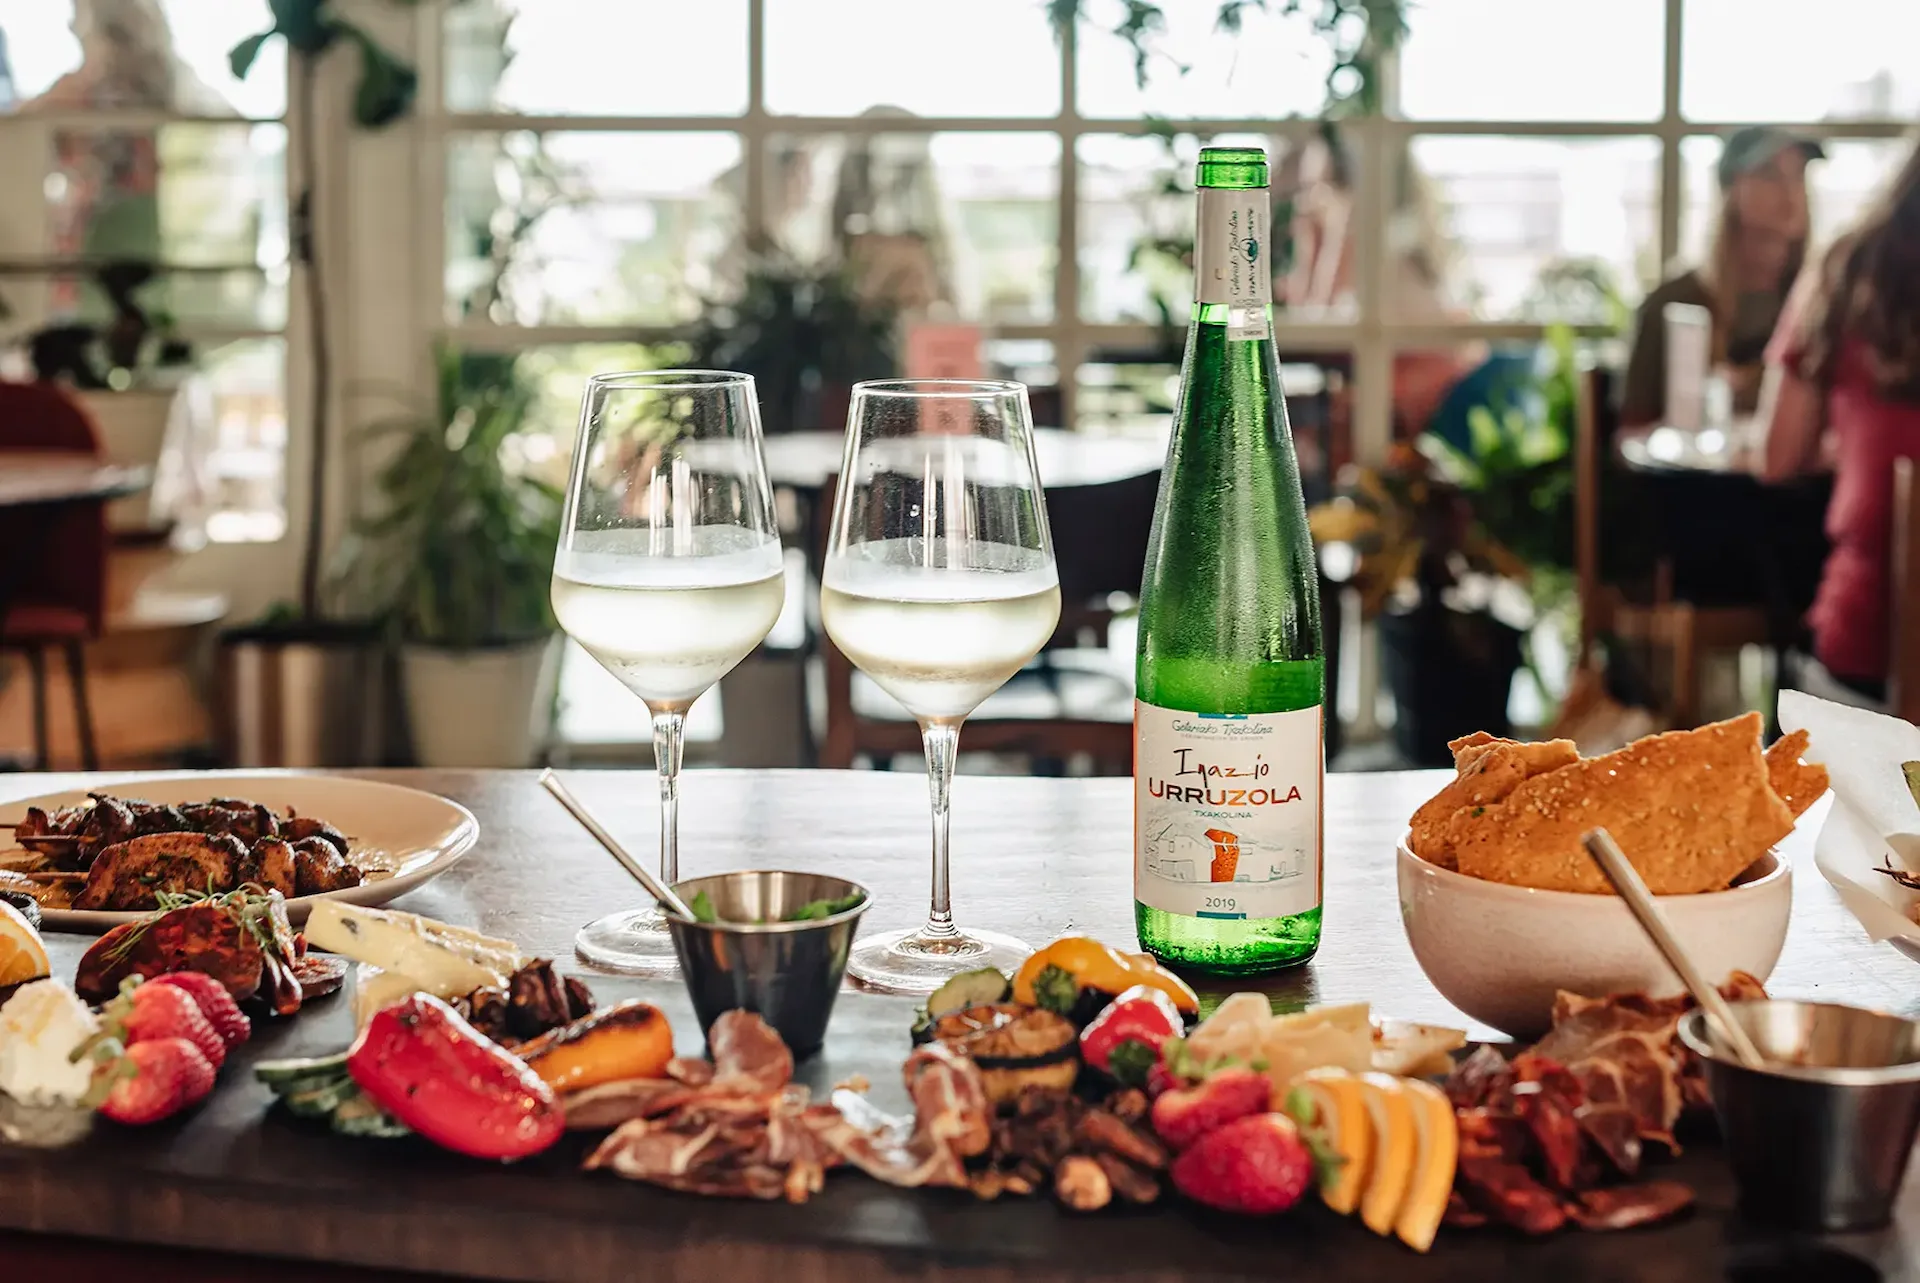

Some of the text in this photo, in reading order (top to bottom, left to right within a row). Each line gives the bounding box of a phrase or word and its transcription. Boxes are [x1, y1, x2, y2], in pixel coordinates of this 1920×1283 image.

[1149, 777, 1302, 806] URRUZOLA
[1194, 809, 1253, 819] TXAKOLINA
[1205, 897, 1236, 911] 2019
